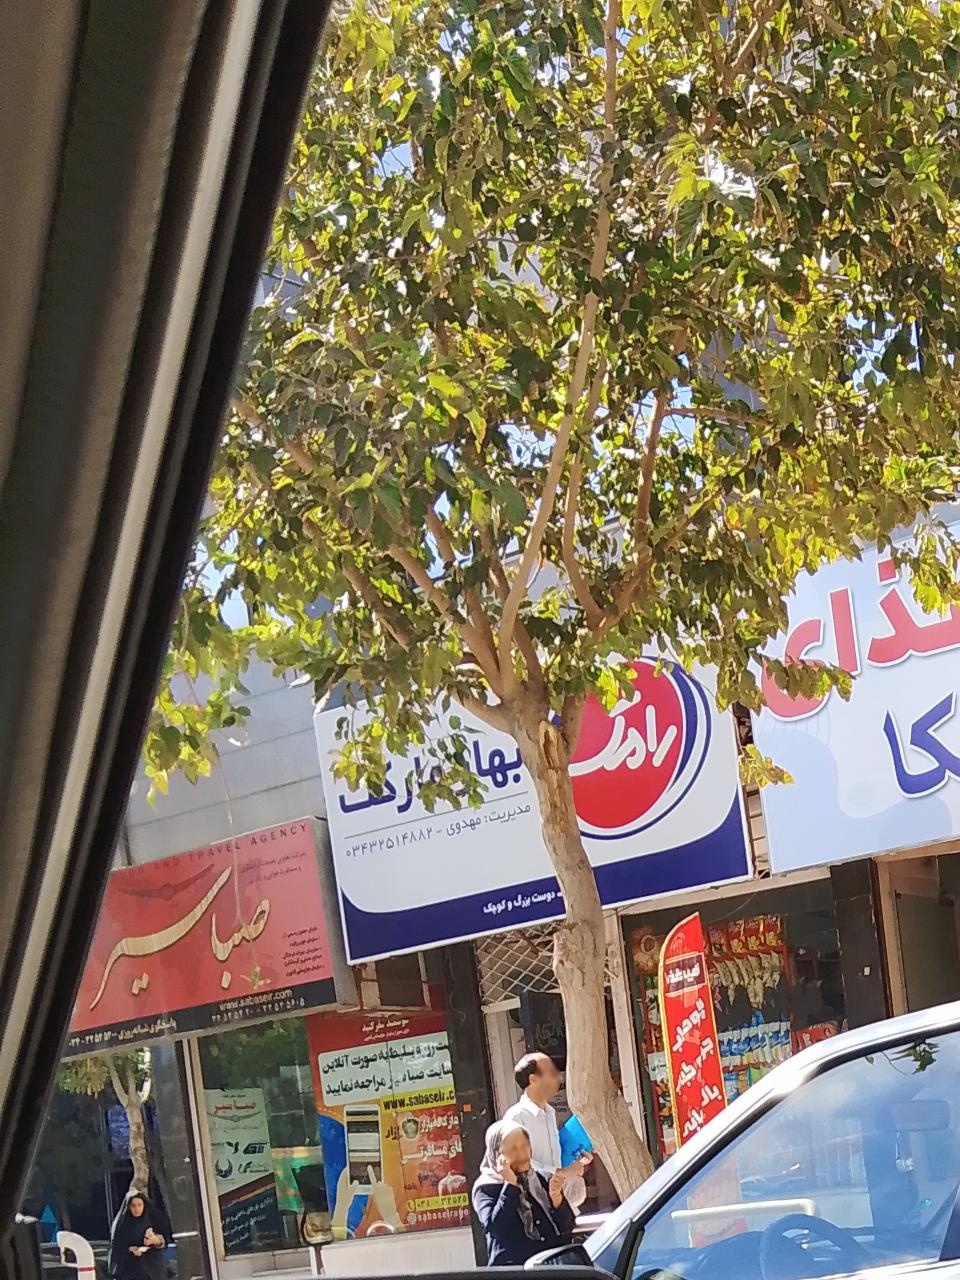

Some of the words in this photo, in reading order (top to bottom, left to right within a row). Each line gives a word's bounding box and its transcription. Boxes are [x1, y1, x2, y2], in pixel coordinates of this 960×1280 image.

[250, 823, 308, 847] AGENCY
[446, 816, 482, 836] مهدوی
[345, 825, 434, 858] ۰۳۴۳۲۵۱۴۸۸۲
[513, 893, 531, 908] بزرگ
[531, 890, 556, 903] دوست
[482, 899, 506, 916] کوچک
